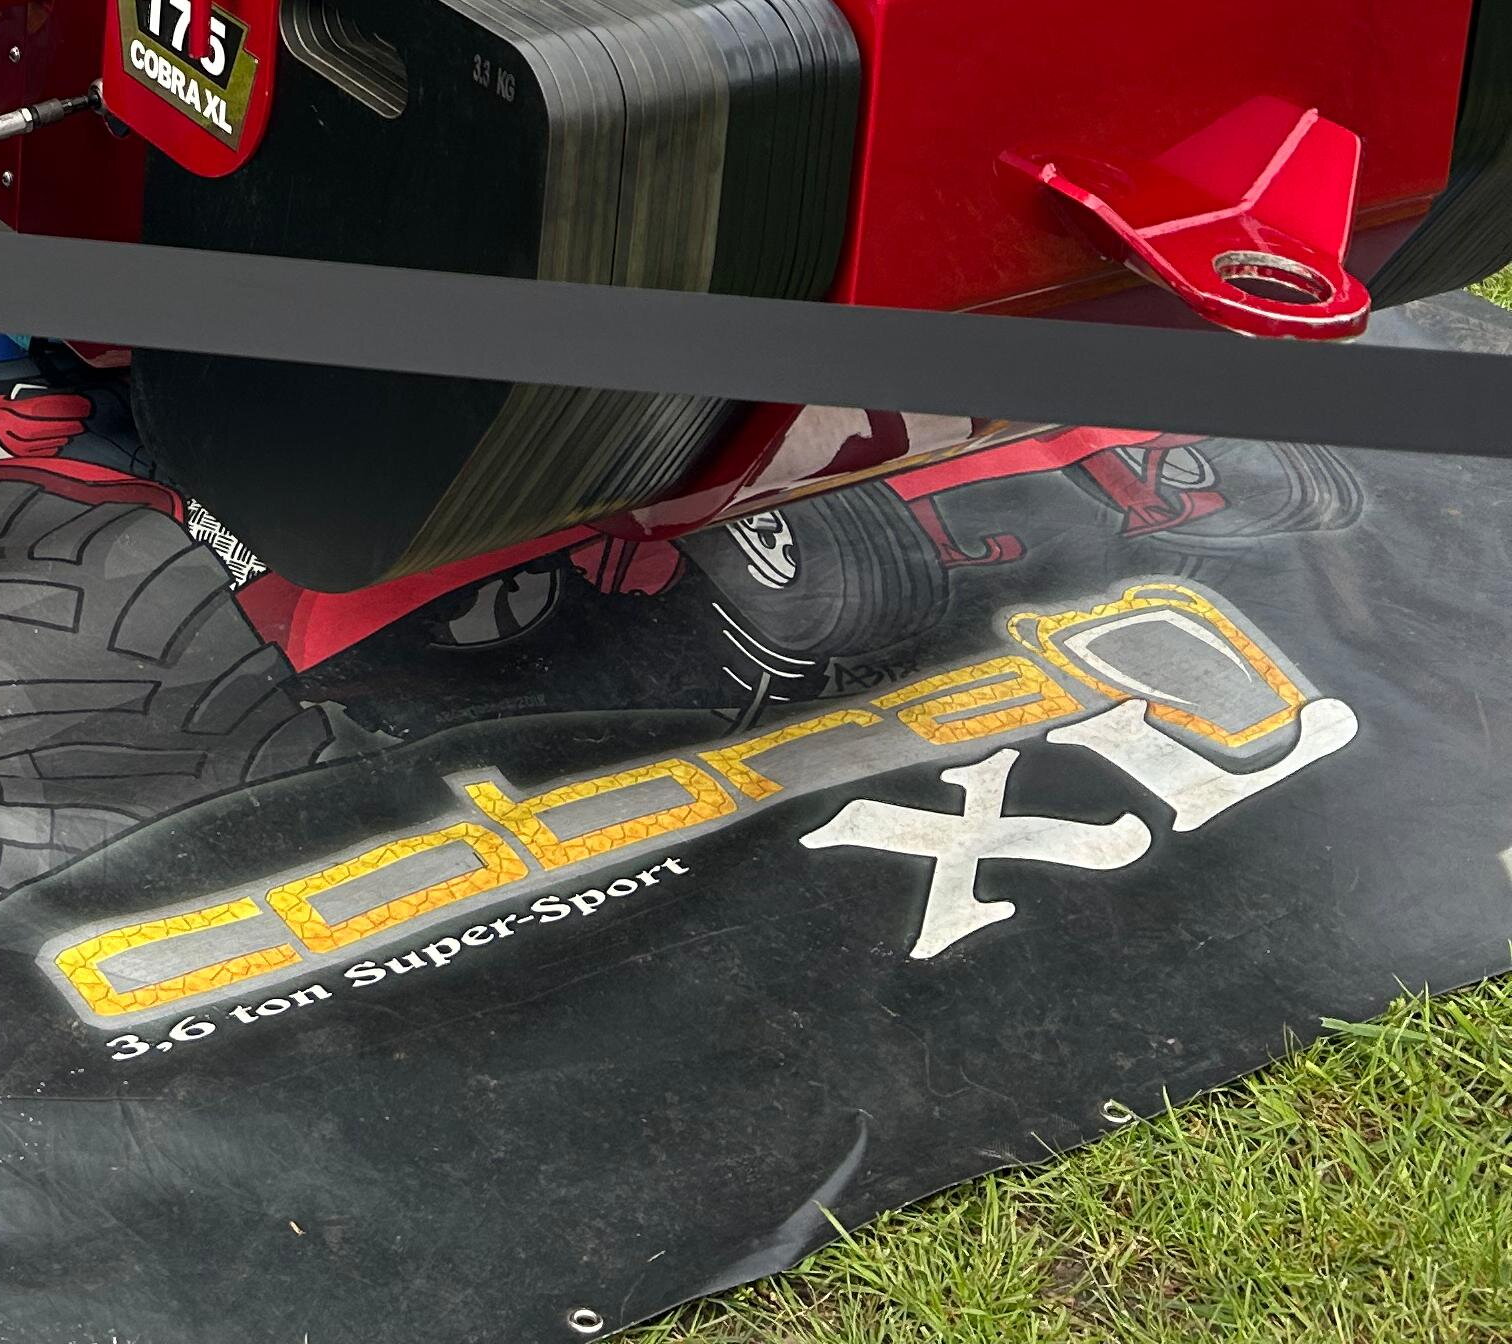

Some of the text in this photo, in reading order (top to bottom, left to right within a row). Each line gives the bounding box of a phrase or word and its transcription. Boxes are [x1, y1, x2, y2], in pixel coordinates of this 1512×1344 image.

[130, 39, 233, 135] COBRA XL
[496, 67, 516, 103] KG
[799, 698, 1361, 960] XL
[105, 855, 690, 1062] 3,6 ton Super-Sport
